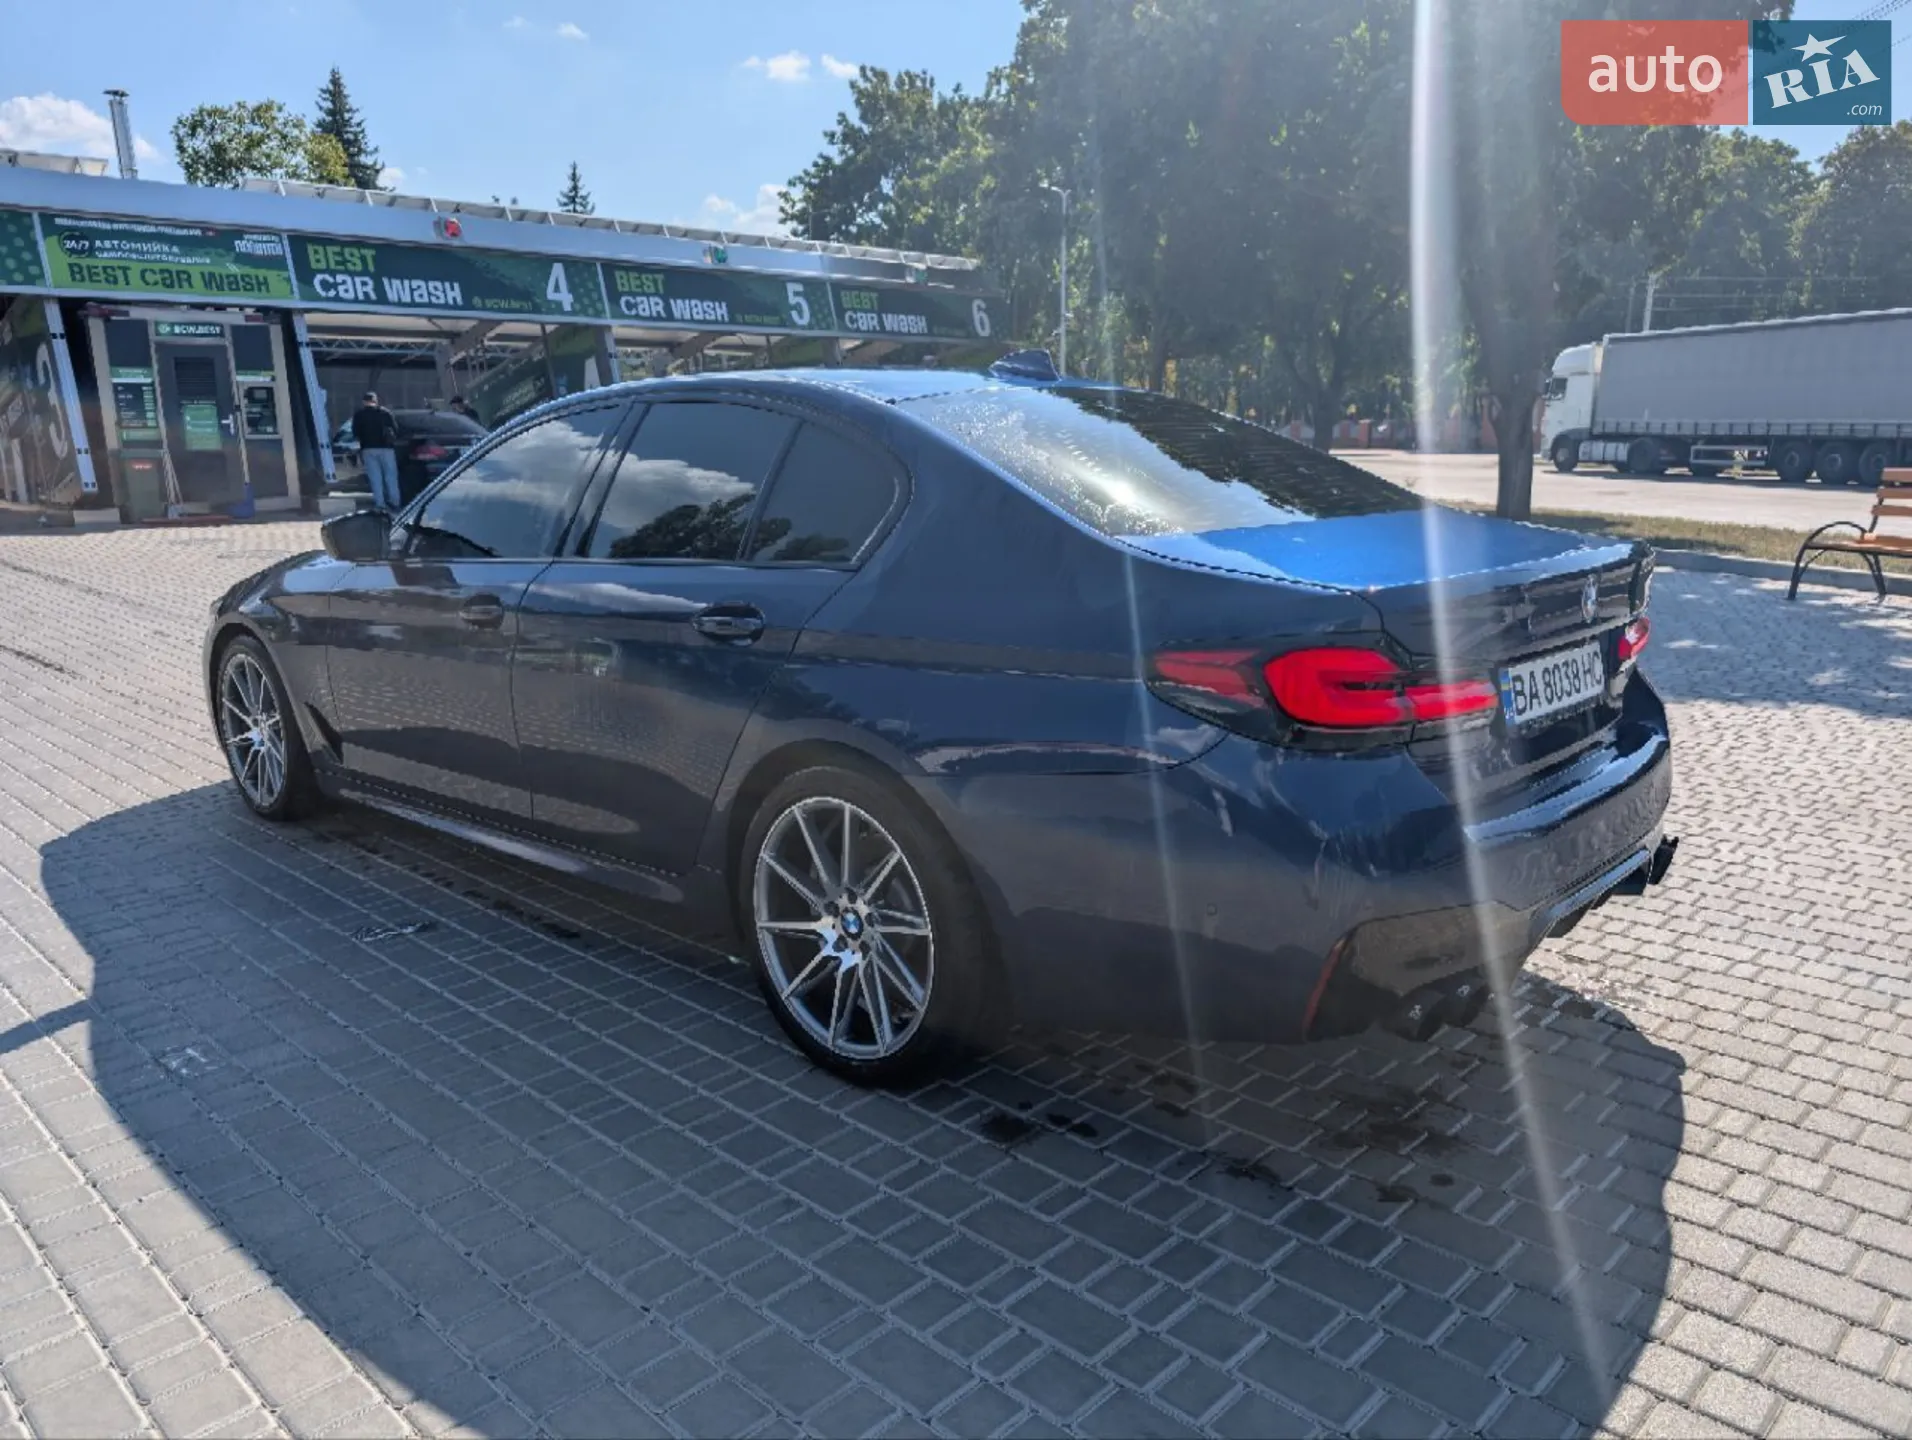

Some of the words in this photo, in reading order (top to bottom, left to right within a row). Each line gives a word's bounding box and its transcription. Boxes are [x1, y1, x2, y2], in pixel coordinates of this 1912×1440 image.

[67, 263, 132, 286] BEST
[307, 244, 376, 272] BEST
[545, 262, 574, 311] 4
[614, 270, 667, 295] BEST
[786, 281, 811, 326] 5
[840, 290, 880, 310] BEST
[971, 299, 991, 337] 6
[1511, 670, 1541, 716] BA
[1543, 660, 1582, 705] 8038
[1583, 650, 1602, 691] HC
